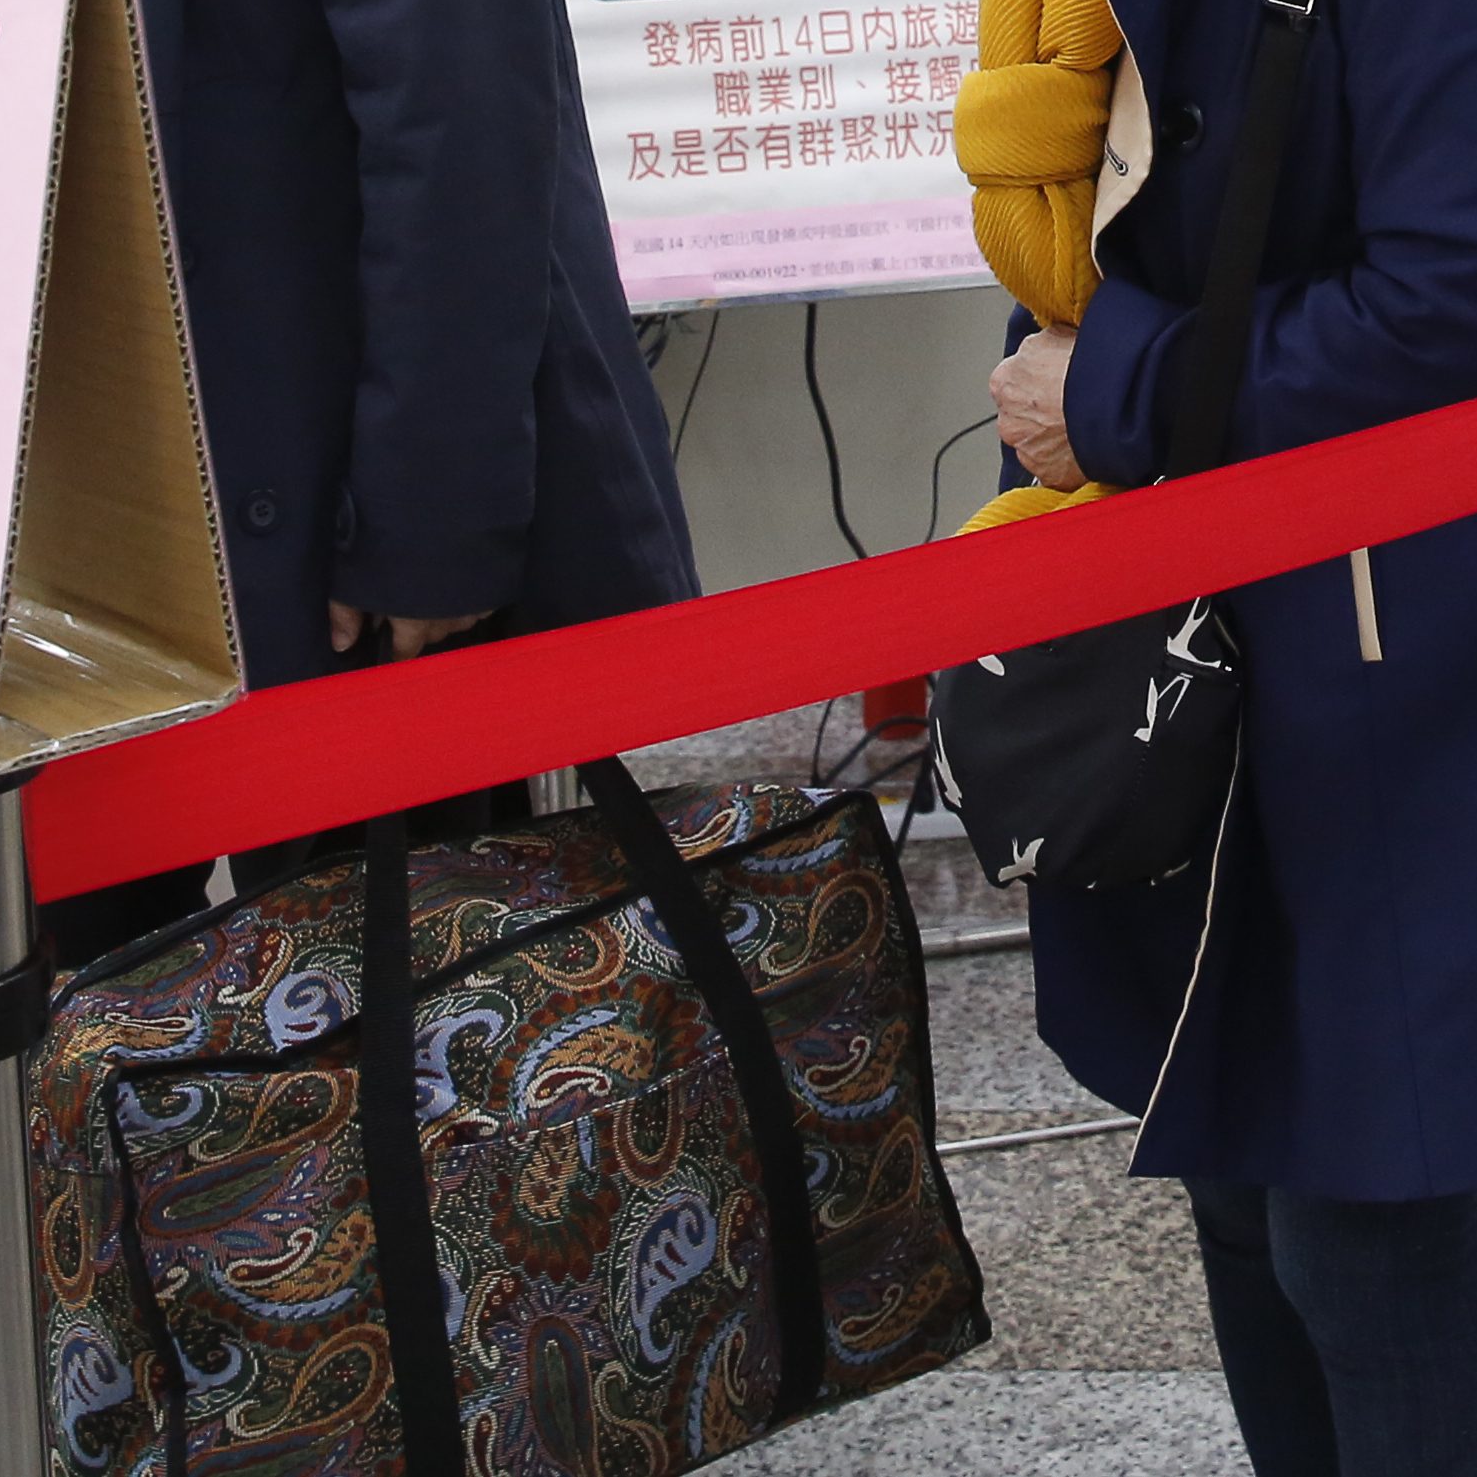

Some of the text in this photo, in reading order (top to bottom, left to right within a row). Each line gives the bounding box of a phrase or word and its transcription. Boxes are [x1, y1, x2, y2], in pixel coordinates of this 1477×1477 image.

[714, 55, 979, 119] 職業別、接觸
[628, 108, 957, 182] 及是否有群聚狀況
